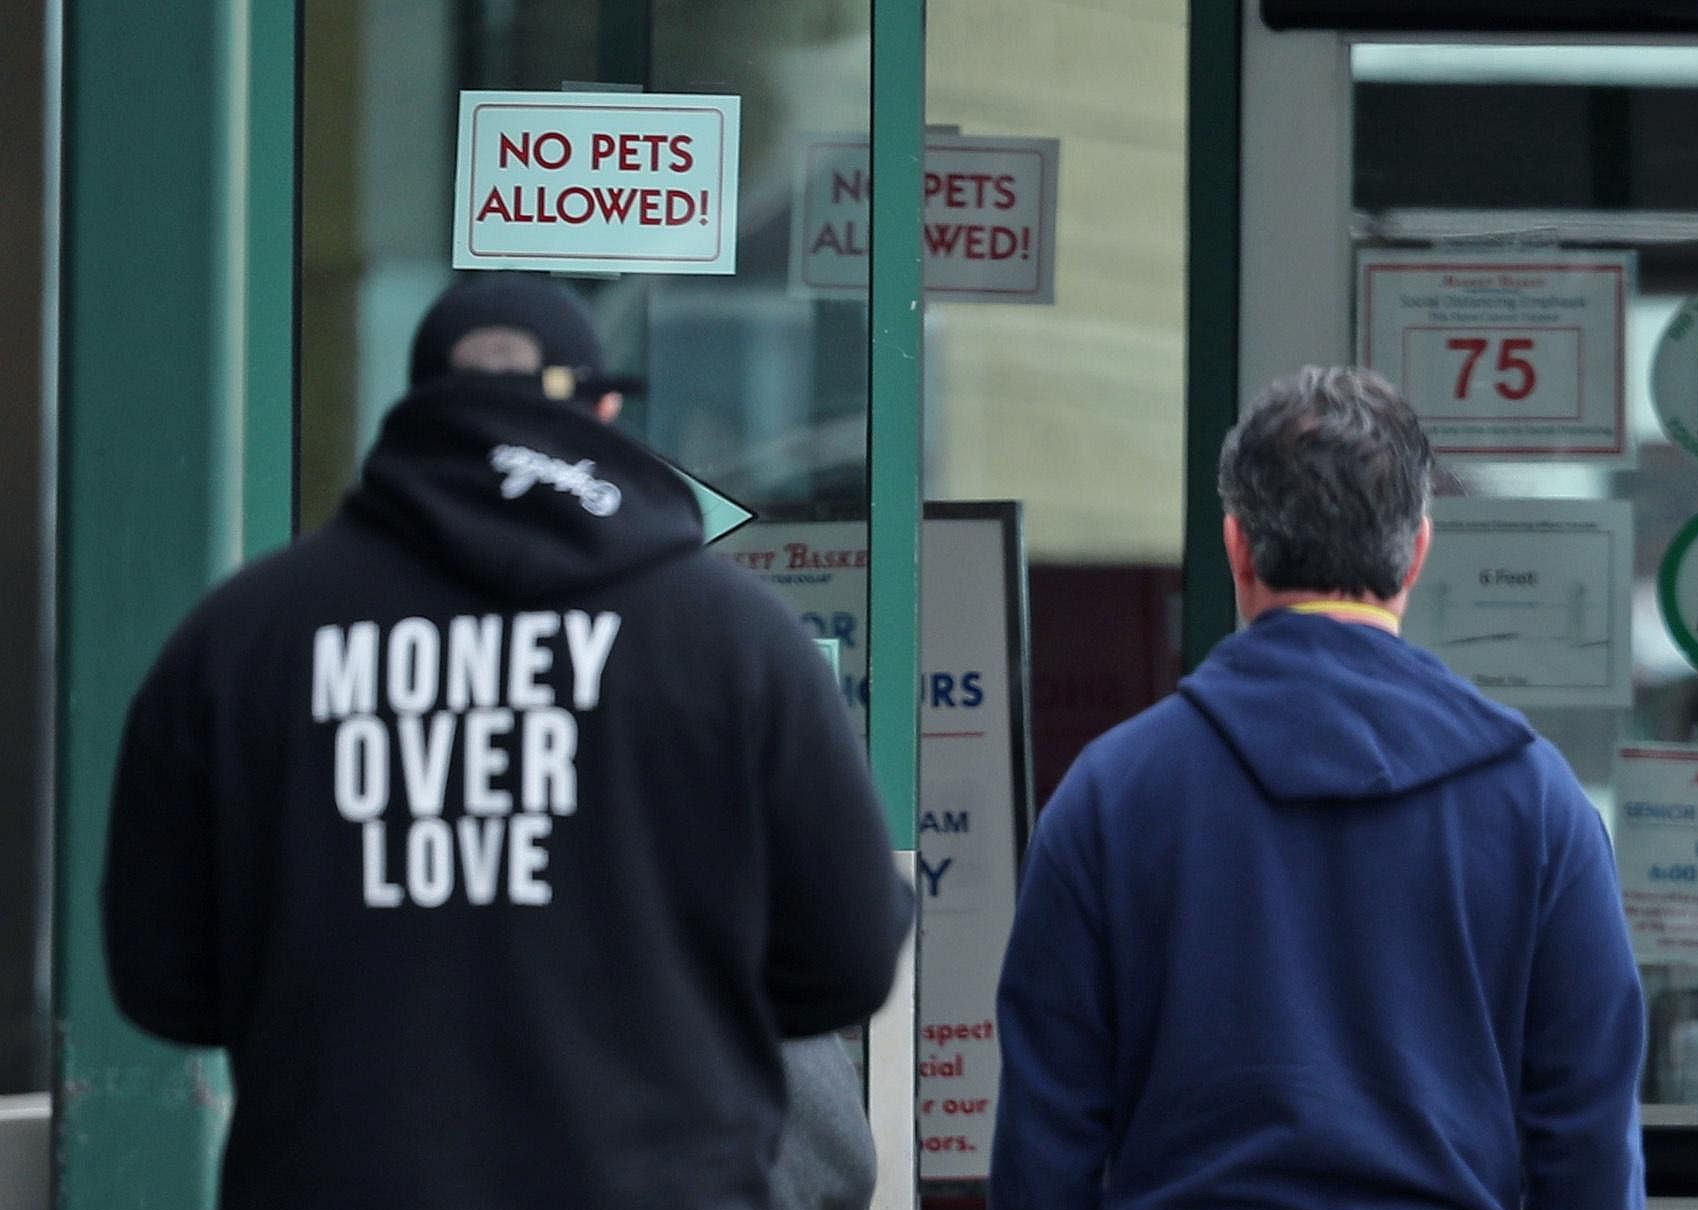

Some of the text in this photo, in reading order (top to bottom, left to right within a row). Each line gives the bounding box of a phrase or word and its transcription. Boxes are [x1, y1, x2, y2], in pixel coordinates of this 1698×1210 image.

[500, 131, 694, 173] NO PETS
[476, 184, 710, 227] ALLOWED!
[924, 172, 1016, 209] PETS
[810, 221, 1031, 261] ALWED!
[1446, 338, 1538, 400] 75
[784, 543, 868, 569] BASKE
[312, 609, 622, 723] MONEY
[334, 706, 579, 822] OVER
[919, 810, 970, 834] AM
[1624, 800, 1696, 819] SENIOR
[362, 813, 552, 908] LOVE
[922, 1019, 993, 1046] spect
[919, 1052, 964, 1078] cial
[942, 1099, 988, 1115] our
